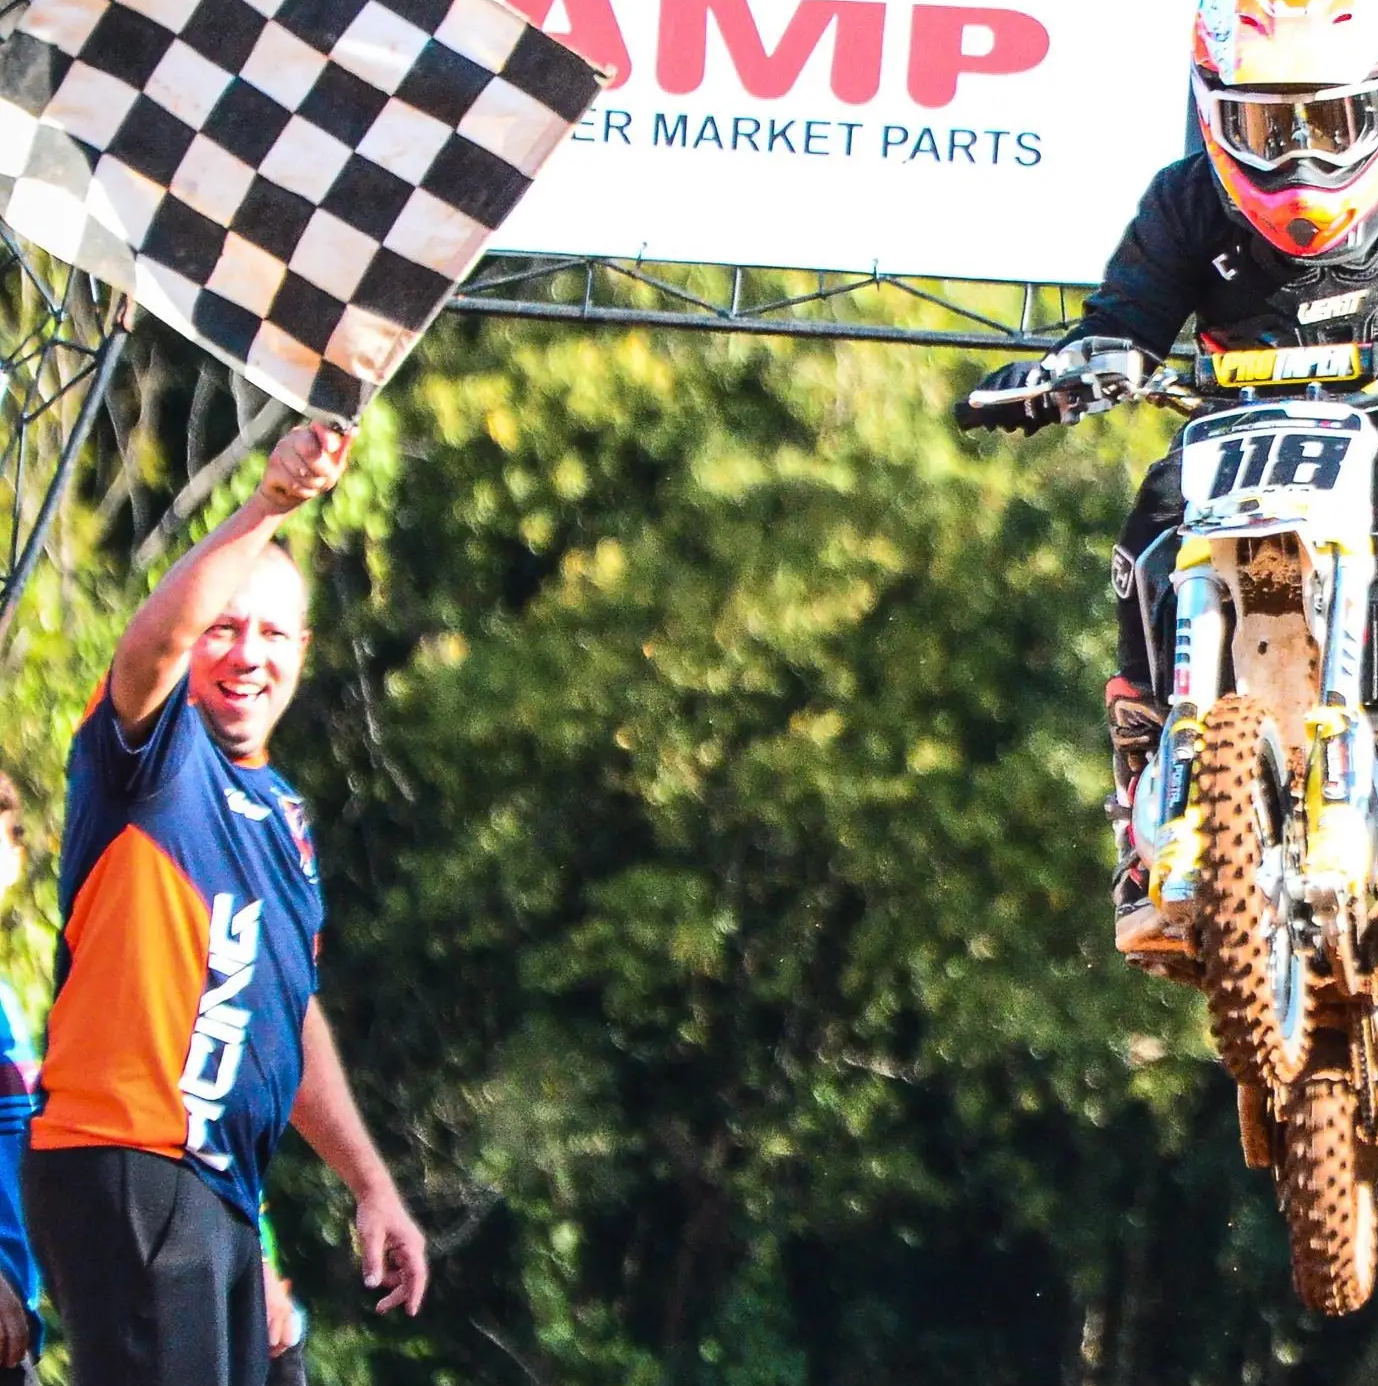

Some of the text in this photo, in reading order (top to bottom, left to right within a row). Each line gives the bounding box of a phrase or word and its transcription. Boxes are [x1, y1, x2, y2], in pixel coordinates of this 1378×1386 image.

[654, 113, 863, 156] MARKET
[882, 125, 1042, 167] PARTS
[1208, 433, 1352, 500] 118
